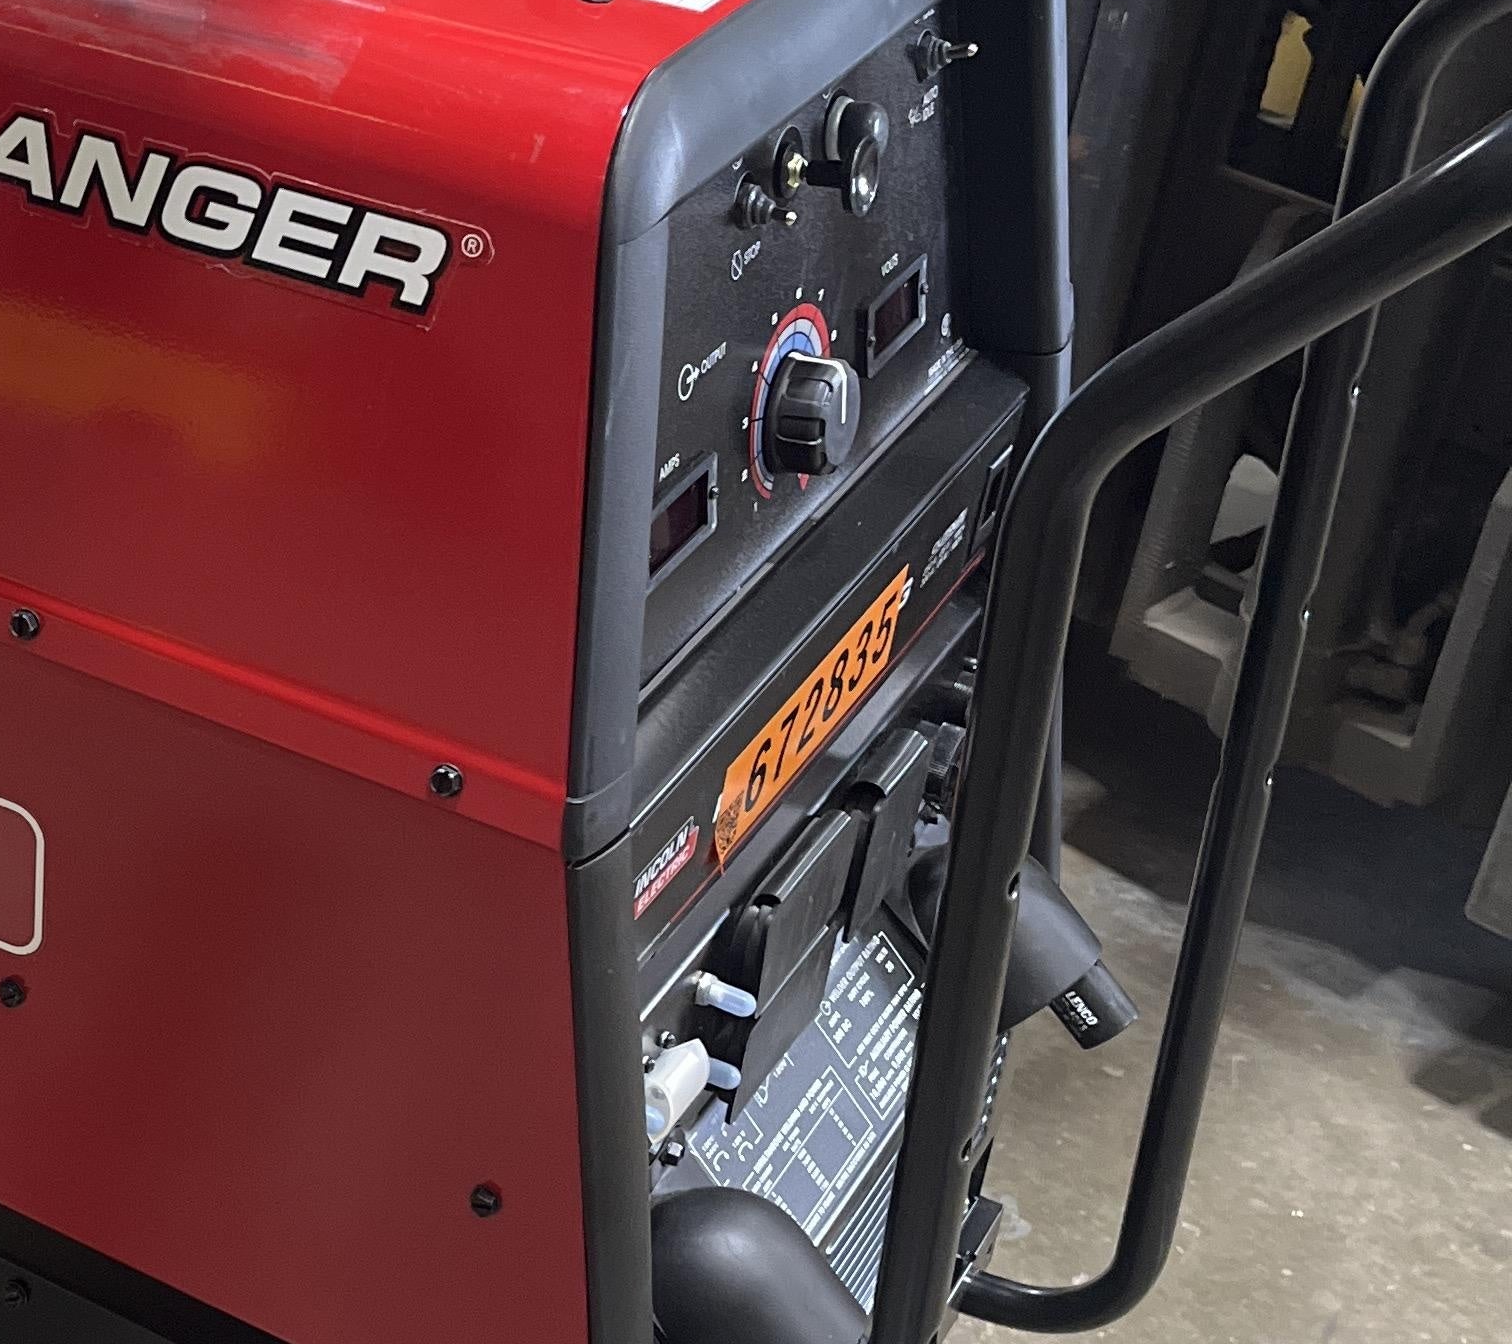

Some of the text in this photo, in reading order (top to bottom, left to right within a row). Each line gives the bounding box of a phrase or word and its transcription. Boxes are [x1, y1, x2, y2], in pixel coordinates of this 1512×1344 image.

[744, 591, 897, 812] 672835
[634, 825, 689, 899] LINCOLN
[638, 844, 690, 913] ELECTRIC
[1065, 991, 1098, 1025] LENCO
